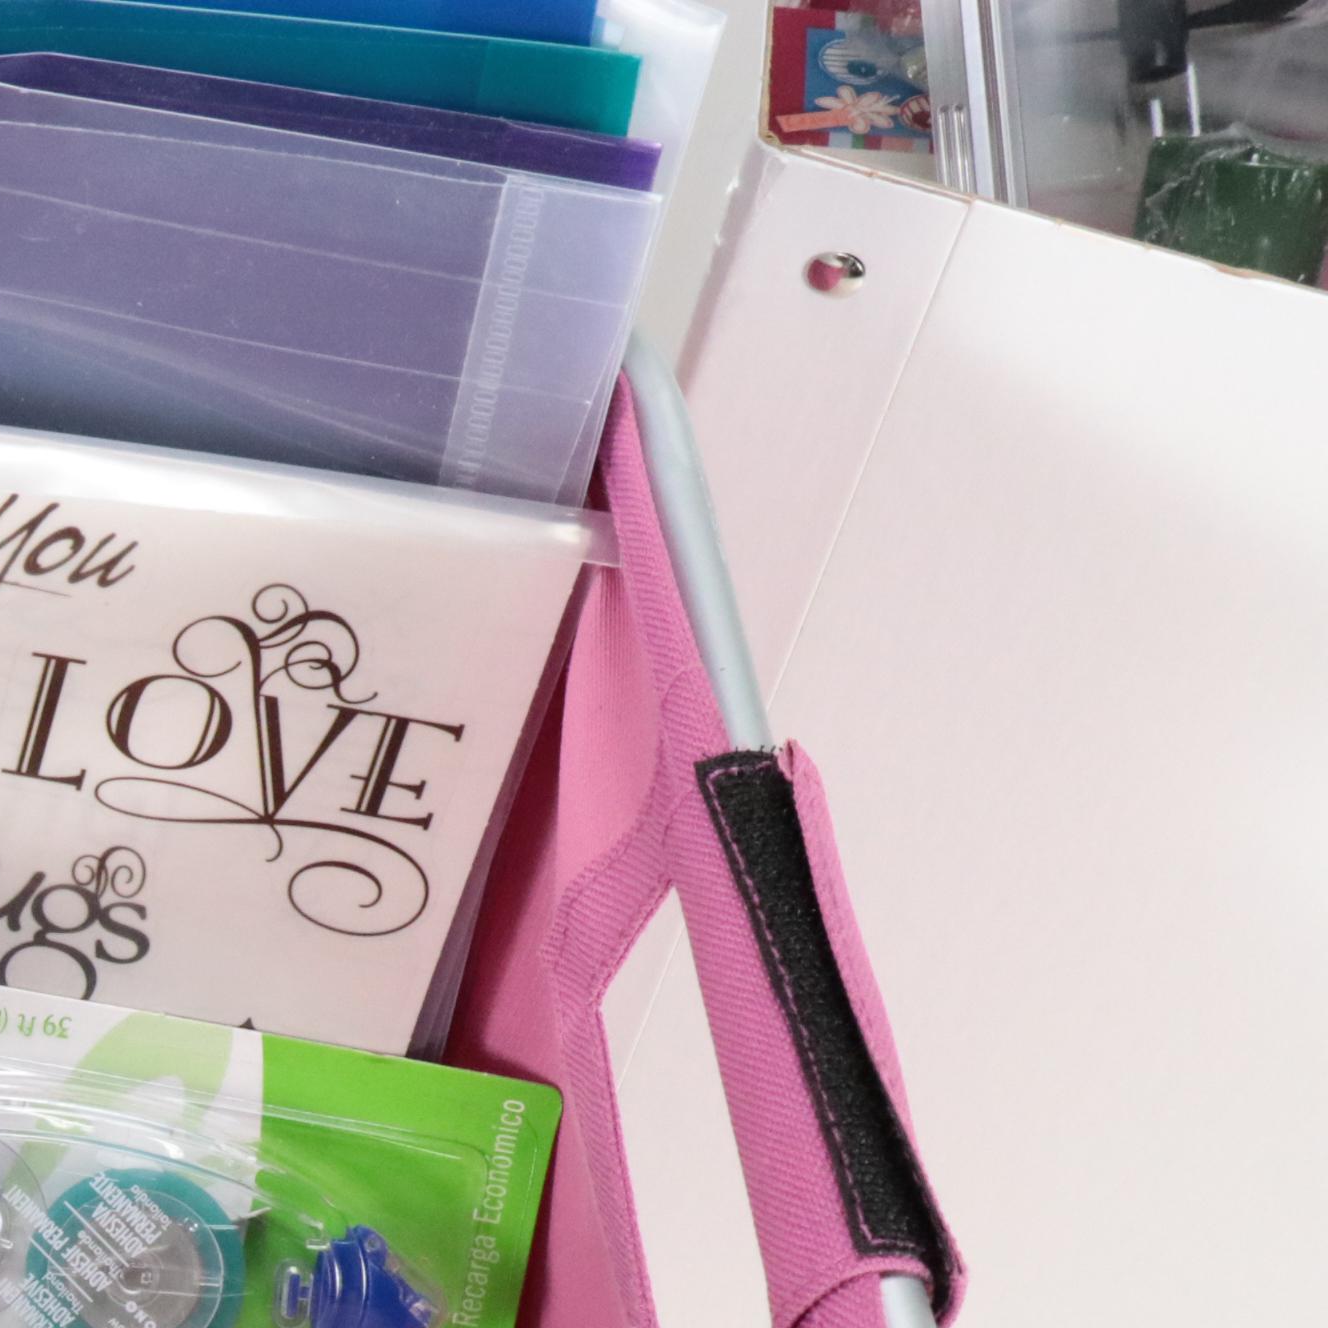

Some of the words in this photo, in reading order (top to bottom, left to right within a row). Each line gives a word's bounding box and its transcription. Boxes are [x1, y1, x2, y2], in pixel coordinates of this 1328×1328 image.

[1, 600, 465, 914] LOVE
[17, 1012, 36, 1038] ft
[44, 1015, 73, 1040] 39
[472, 1098, 526, 1226] Económico
[1, 1183, 71, 1252] PERMANENT
[88, 1170, 163, 1246] PERMANENTE
[90, 1200, 148, 1258] ADHESIVA
[22, 1271, 77, 1328] ADHESIVE
[451, 1233, 501, 1328] Recarga
